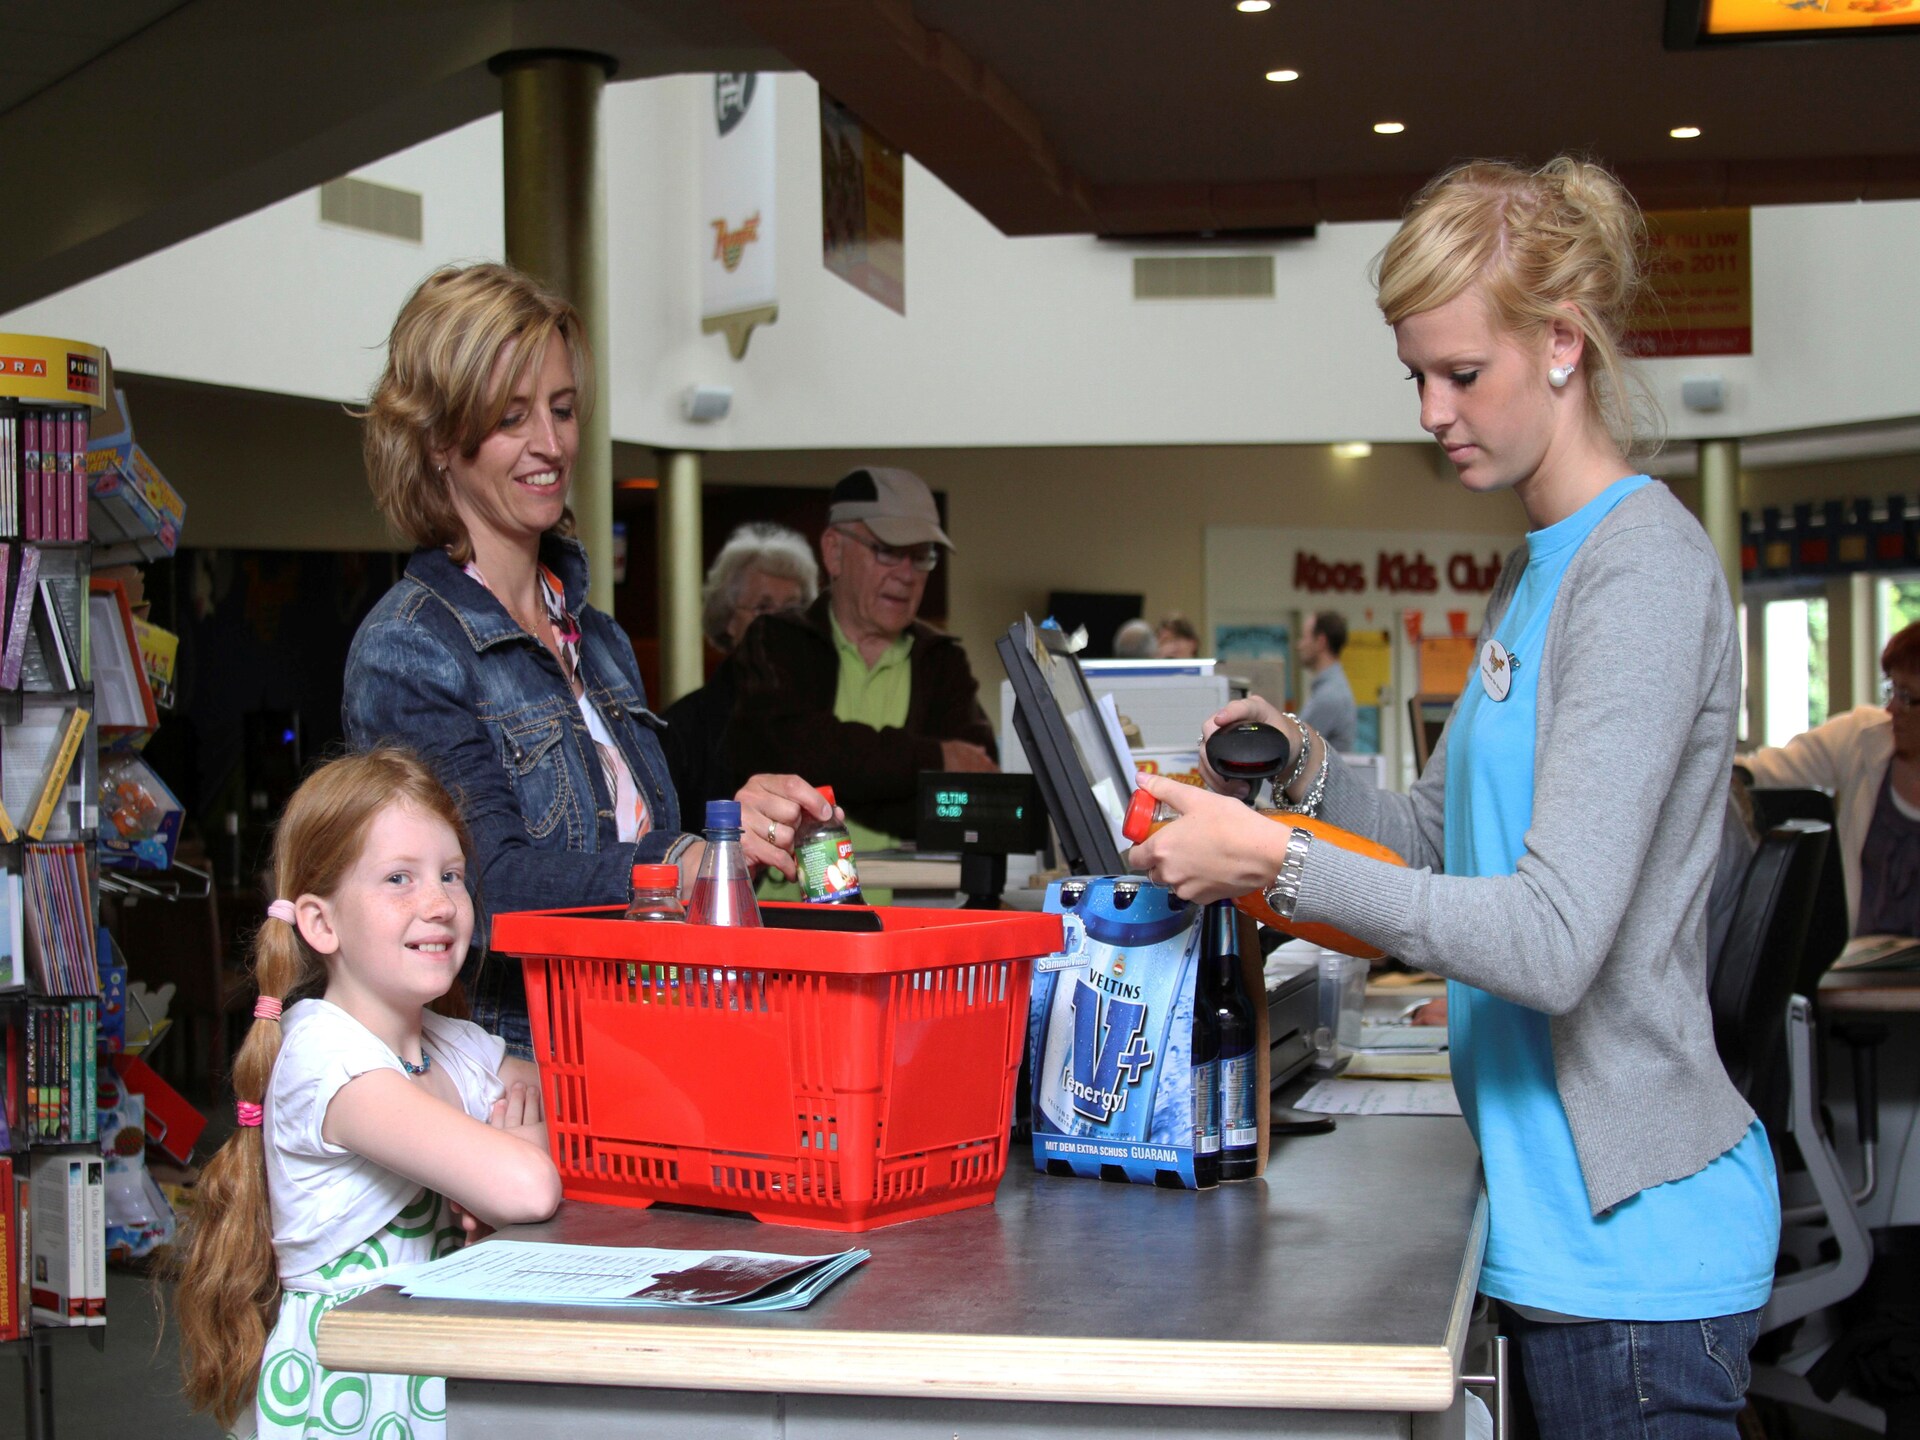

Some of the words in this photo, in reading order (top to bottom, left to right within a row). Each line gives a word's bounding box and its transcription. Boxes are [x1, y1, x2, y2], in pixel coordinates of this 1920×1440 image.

[1690, 254, 1737, 273] 2011
[1293, 549, 1367, 595] Koos
[1376, 549, 1439, 595] Kids
[936, 791, 969, 805] VELTINS
[1088, 967, 1142, 1000] VELTINS
[1045, 1141, 1059, 1152] MIT
[1059, 1142, 1076, 1153] DEM
[1076, 1144, 1099, 1156] EXTRA
[1099, 1146, 1128, 1158] SCHUSS
[1130, 1146, 1179, 1163] GUARANA
